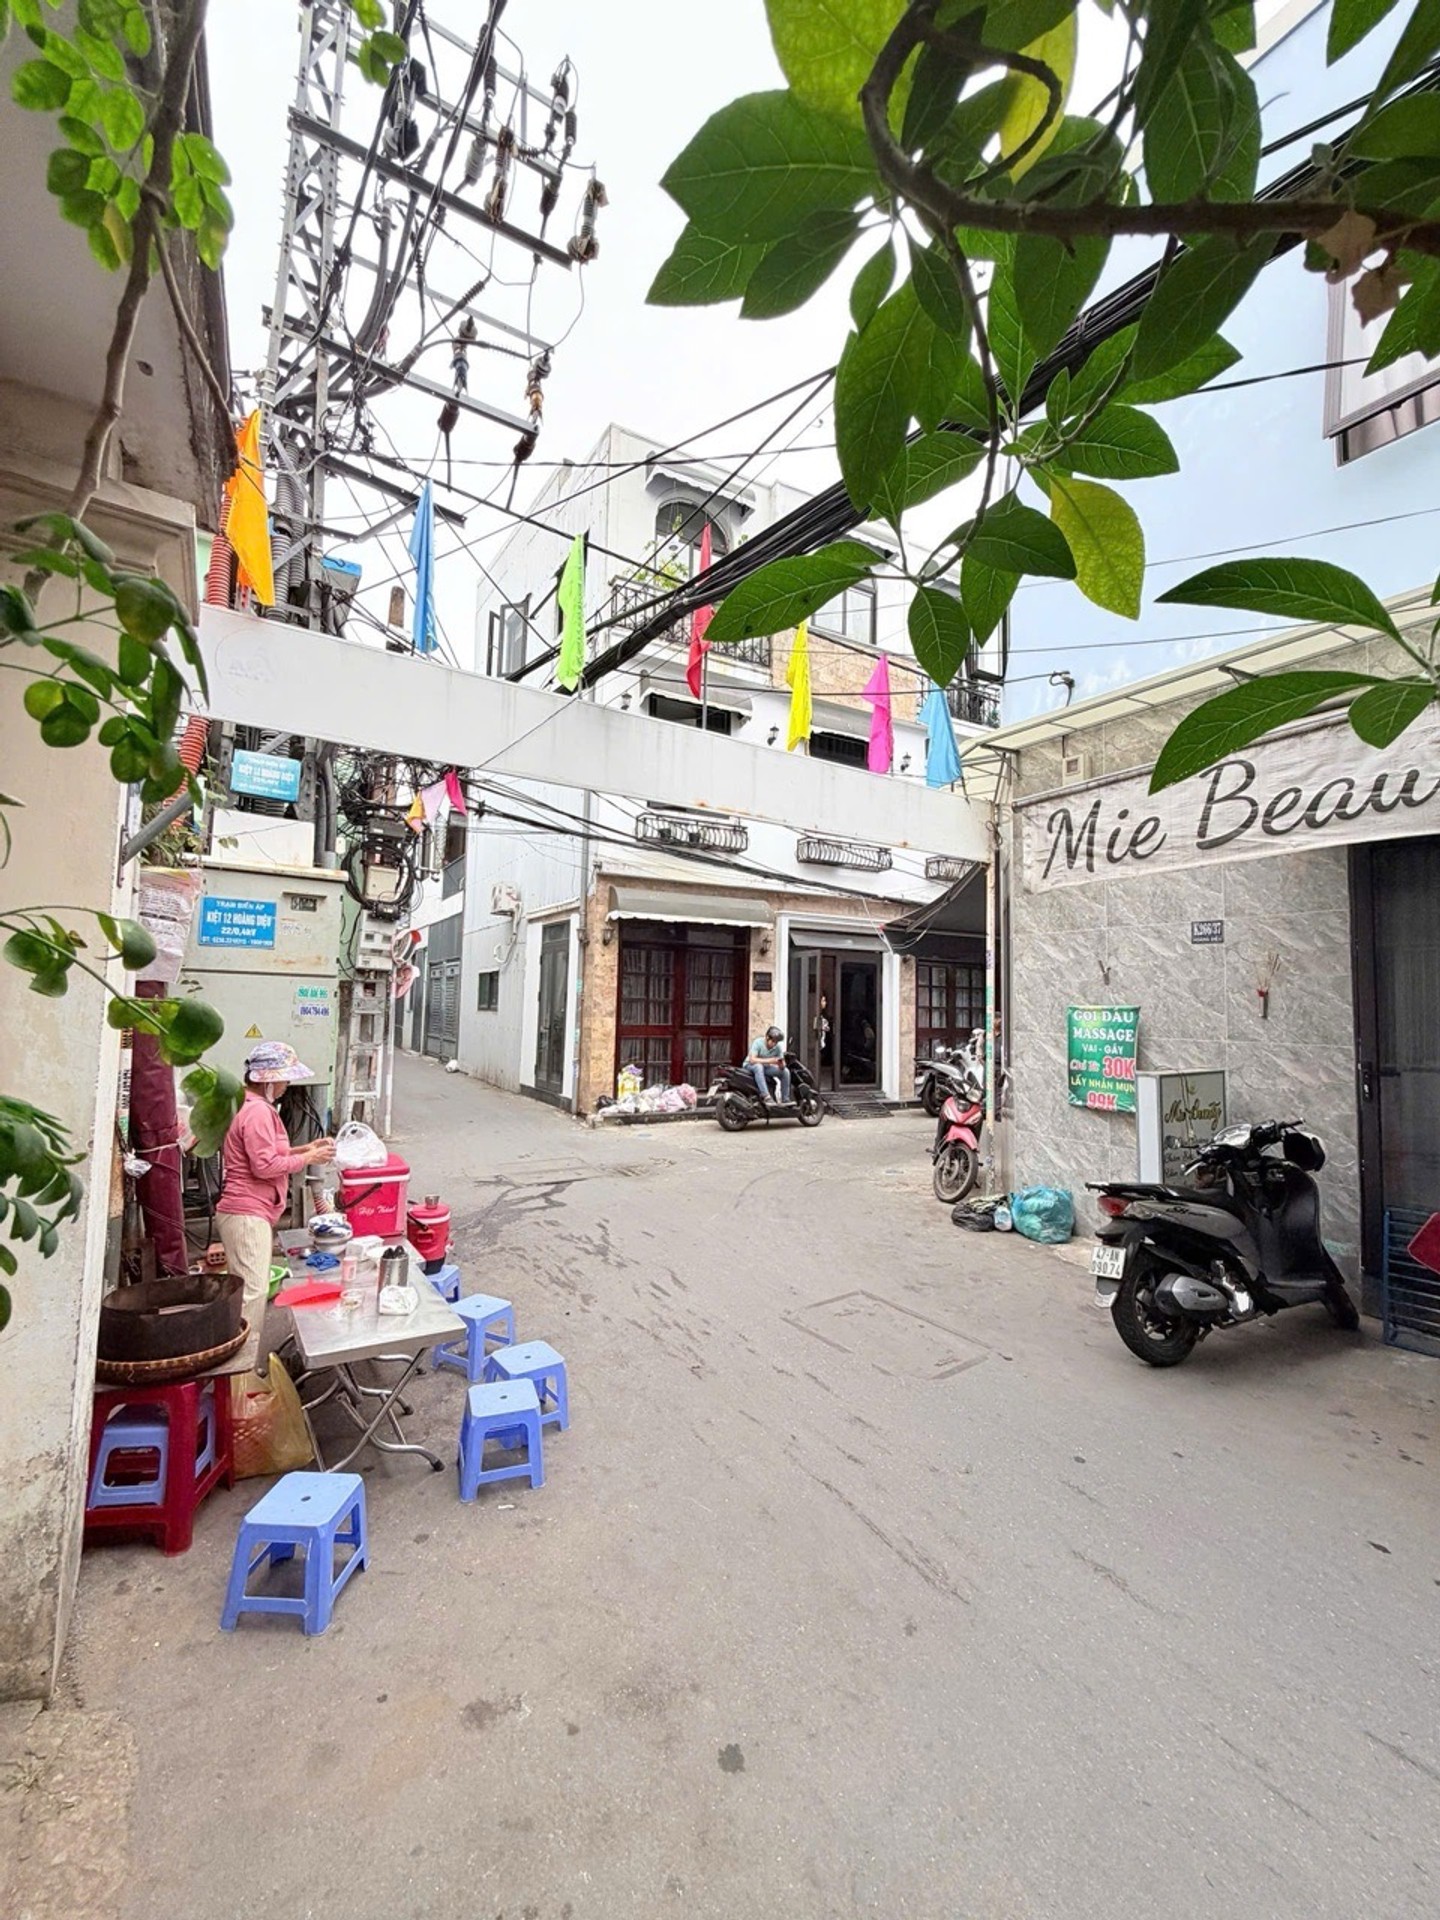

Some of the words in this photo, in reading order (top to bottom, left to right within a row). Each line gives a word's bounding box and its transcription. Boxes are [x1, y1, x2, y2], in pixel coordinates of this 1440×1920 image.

[1042, 799, 1166, 880] Mie
[223, 911, 232, 924] 12
[1073, 1026, 1134, 1042] MASSAGE
[1082, 1043, 1097, 1053] VAI
[1103, 1056, 1136, 1080] 30K
[1087, 1091, 1118, 1110] 99K
